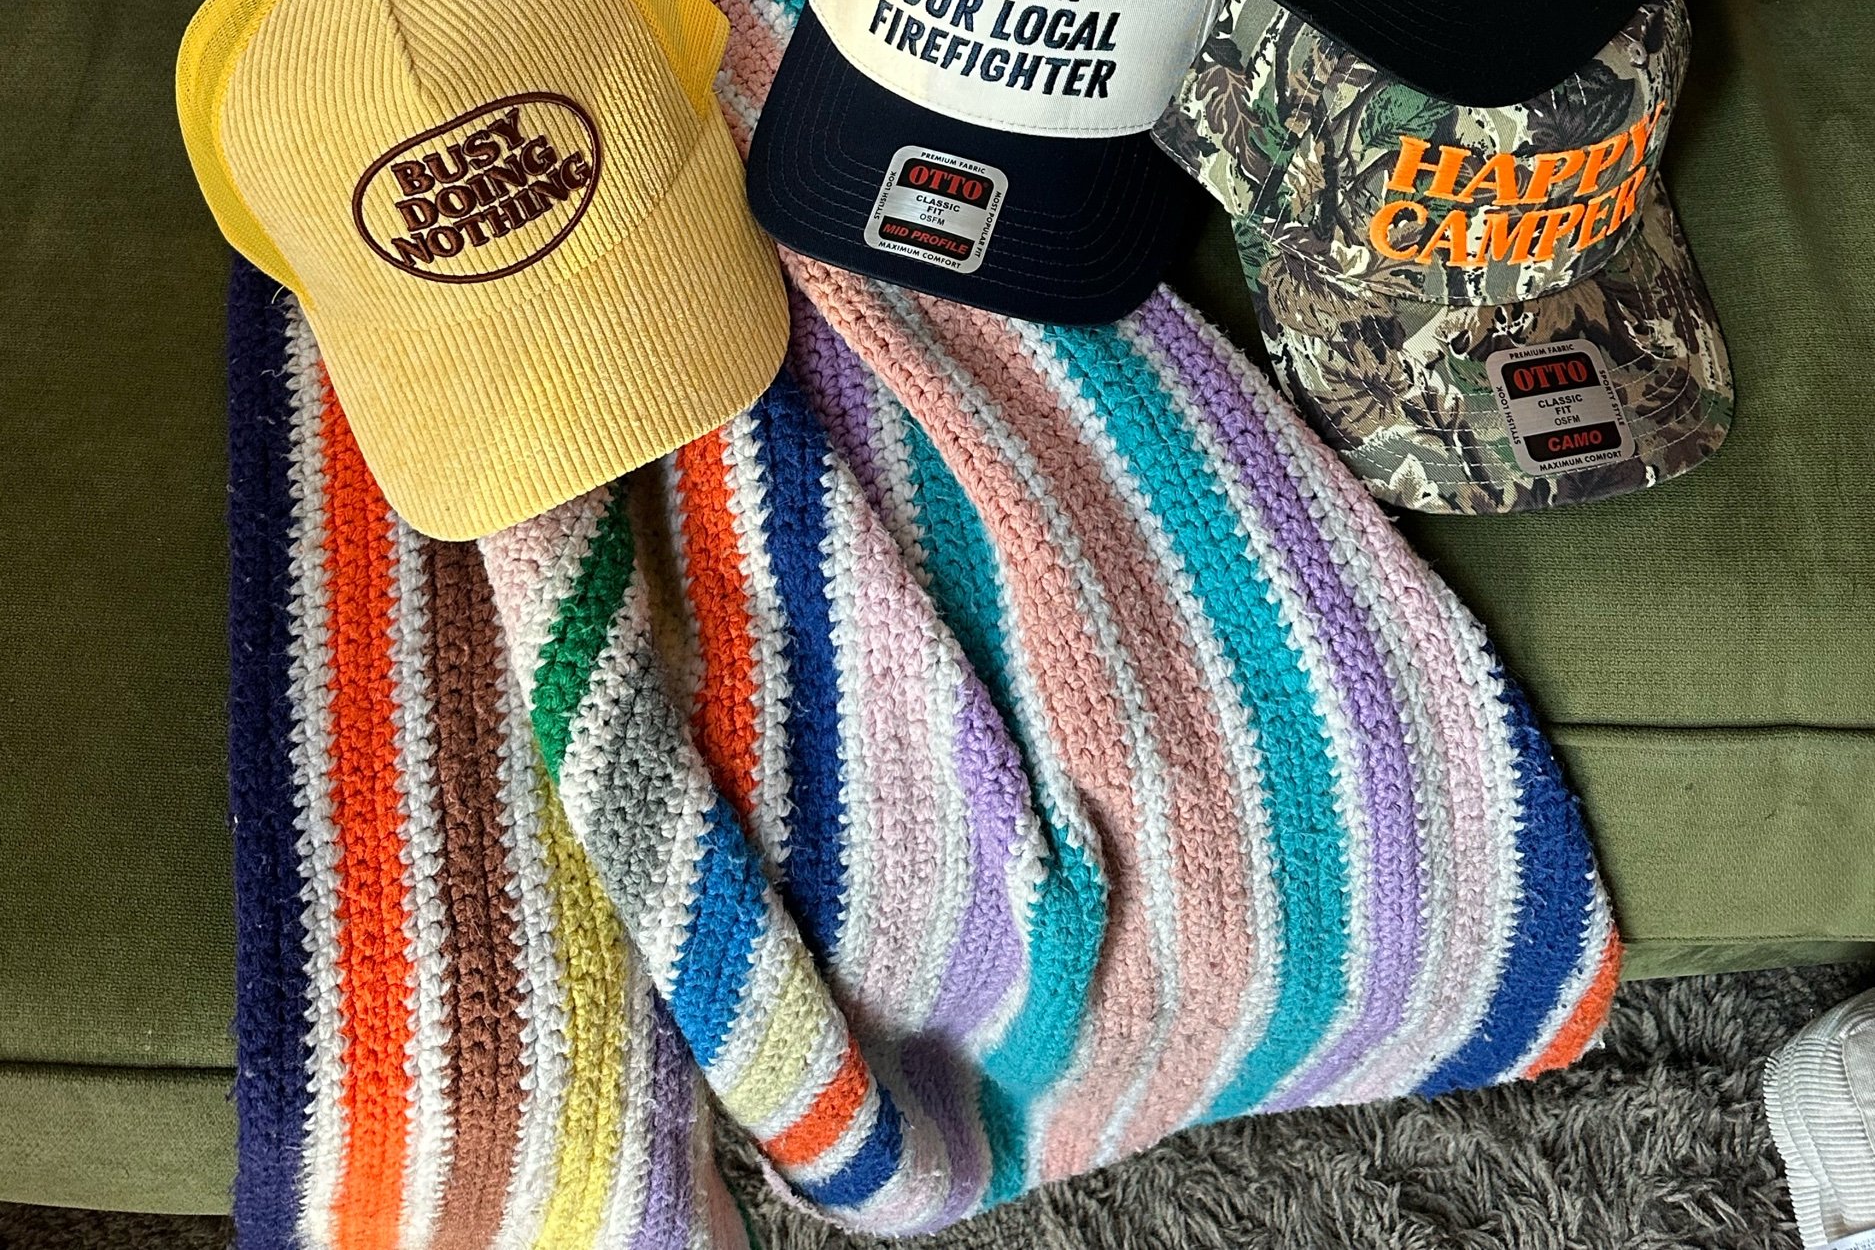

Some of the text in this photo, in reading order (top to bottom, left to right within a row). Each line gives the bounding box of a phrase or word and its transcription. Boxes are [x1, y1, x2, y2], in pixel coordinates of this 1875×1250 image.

[990, 0, 1120, 51] LOCAL
[391, 108, 525, 196] BUSY
[921, 152, 986, 174] PREMIUM FABRIC
[1386, 99, 1666, 206] HAPPY
[395, 135, 558, 232] DOING
[874, 171, 897, 219] STYLISH LOOK
[908, 165, 983, 200] OTTO
[391, 151, 592, 267] NOTHING
[916, 195, 961, 212] CLASSIC
[927, 205, 944, 216] FIT
[1369, 166, 1647, 266] CAMPER
[920, 214, 945, 226] OSFM
[975, 191, 1001, 258] MOST POPULAR FIT
[883, 224, 968, 255] MID PROFILE
[878, 241, 961, 269] MAXIMUM COMFORT
[1509, 344, 1574, 360] PREMIUM FABRIC
[1513, 361, 1587, 391] OTTO
[1538, 394, 1583, 408] CLASSIC
[1555, 405, 1571, 415] FIT
[1599, 370, 1625, 425] SPORTY STYLE
[1496, 386, 1521, 445] STYLISH LOOK
[1554, 415, 1581, 426] OSFM
[1548, 430, 1602, 452] CAMO
[1540, 451, 1622, 472] MAXIMUM COMFORT
